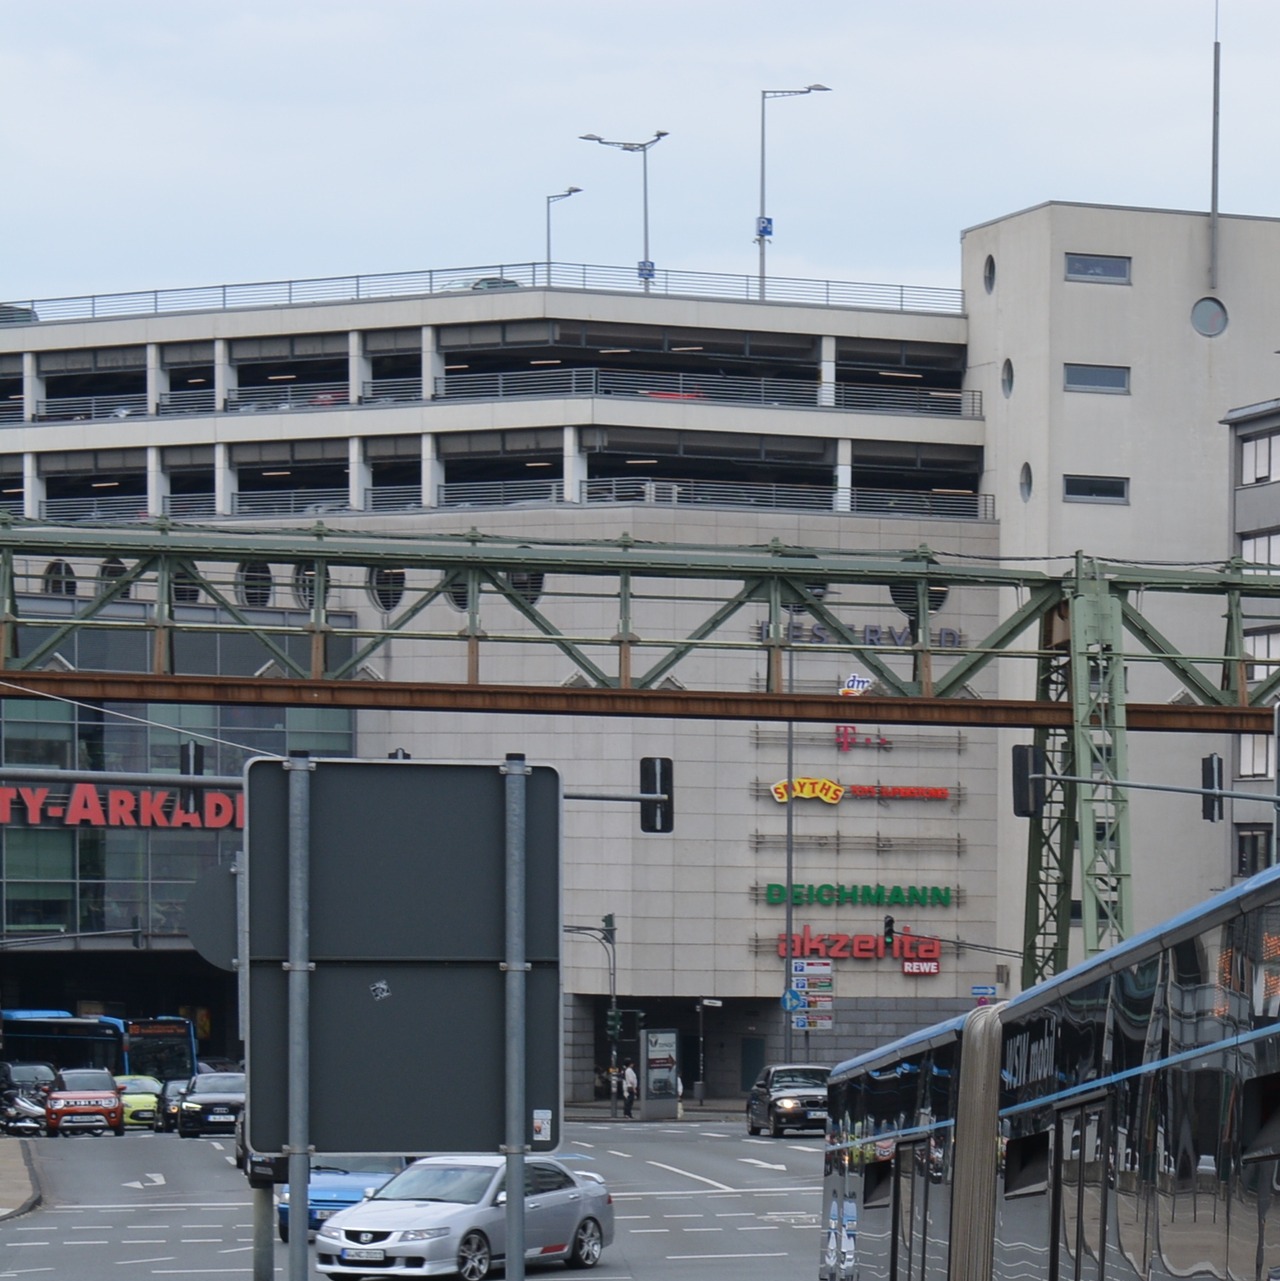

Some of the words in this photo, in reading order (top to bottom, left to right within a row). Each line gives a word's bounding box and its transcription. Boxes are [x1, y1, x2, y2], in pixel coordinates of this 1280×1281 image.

[766, 883, 952, 907] DEICHMANN
[777, 924, 941, 958] akzenta
[904, 961, 938, 973] REWE
